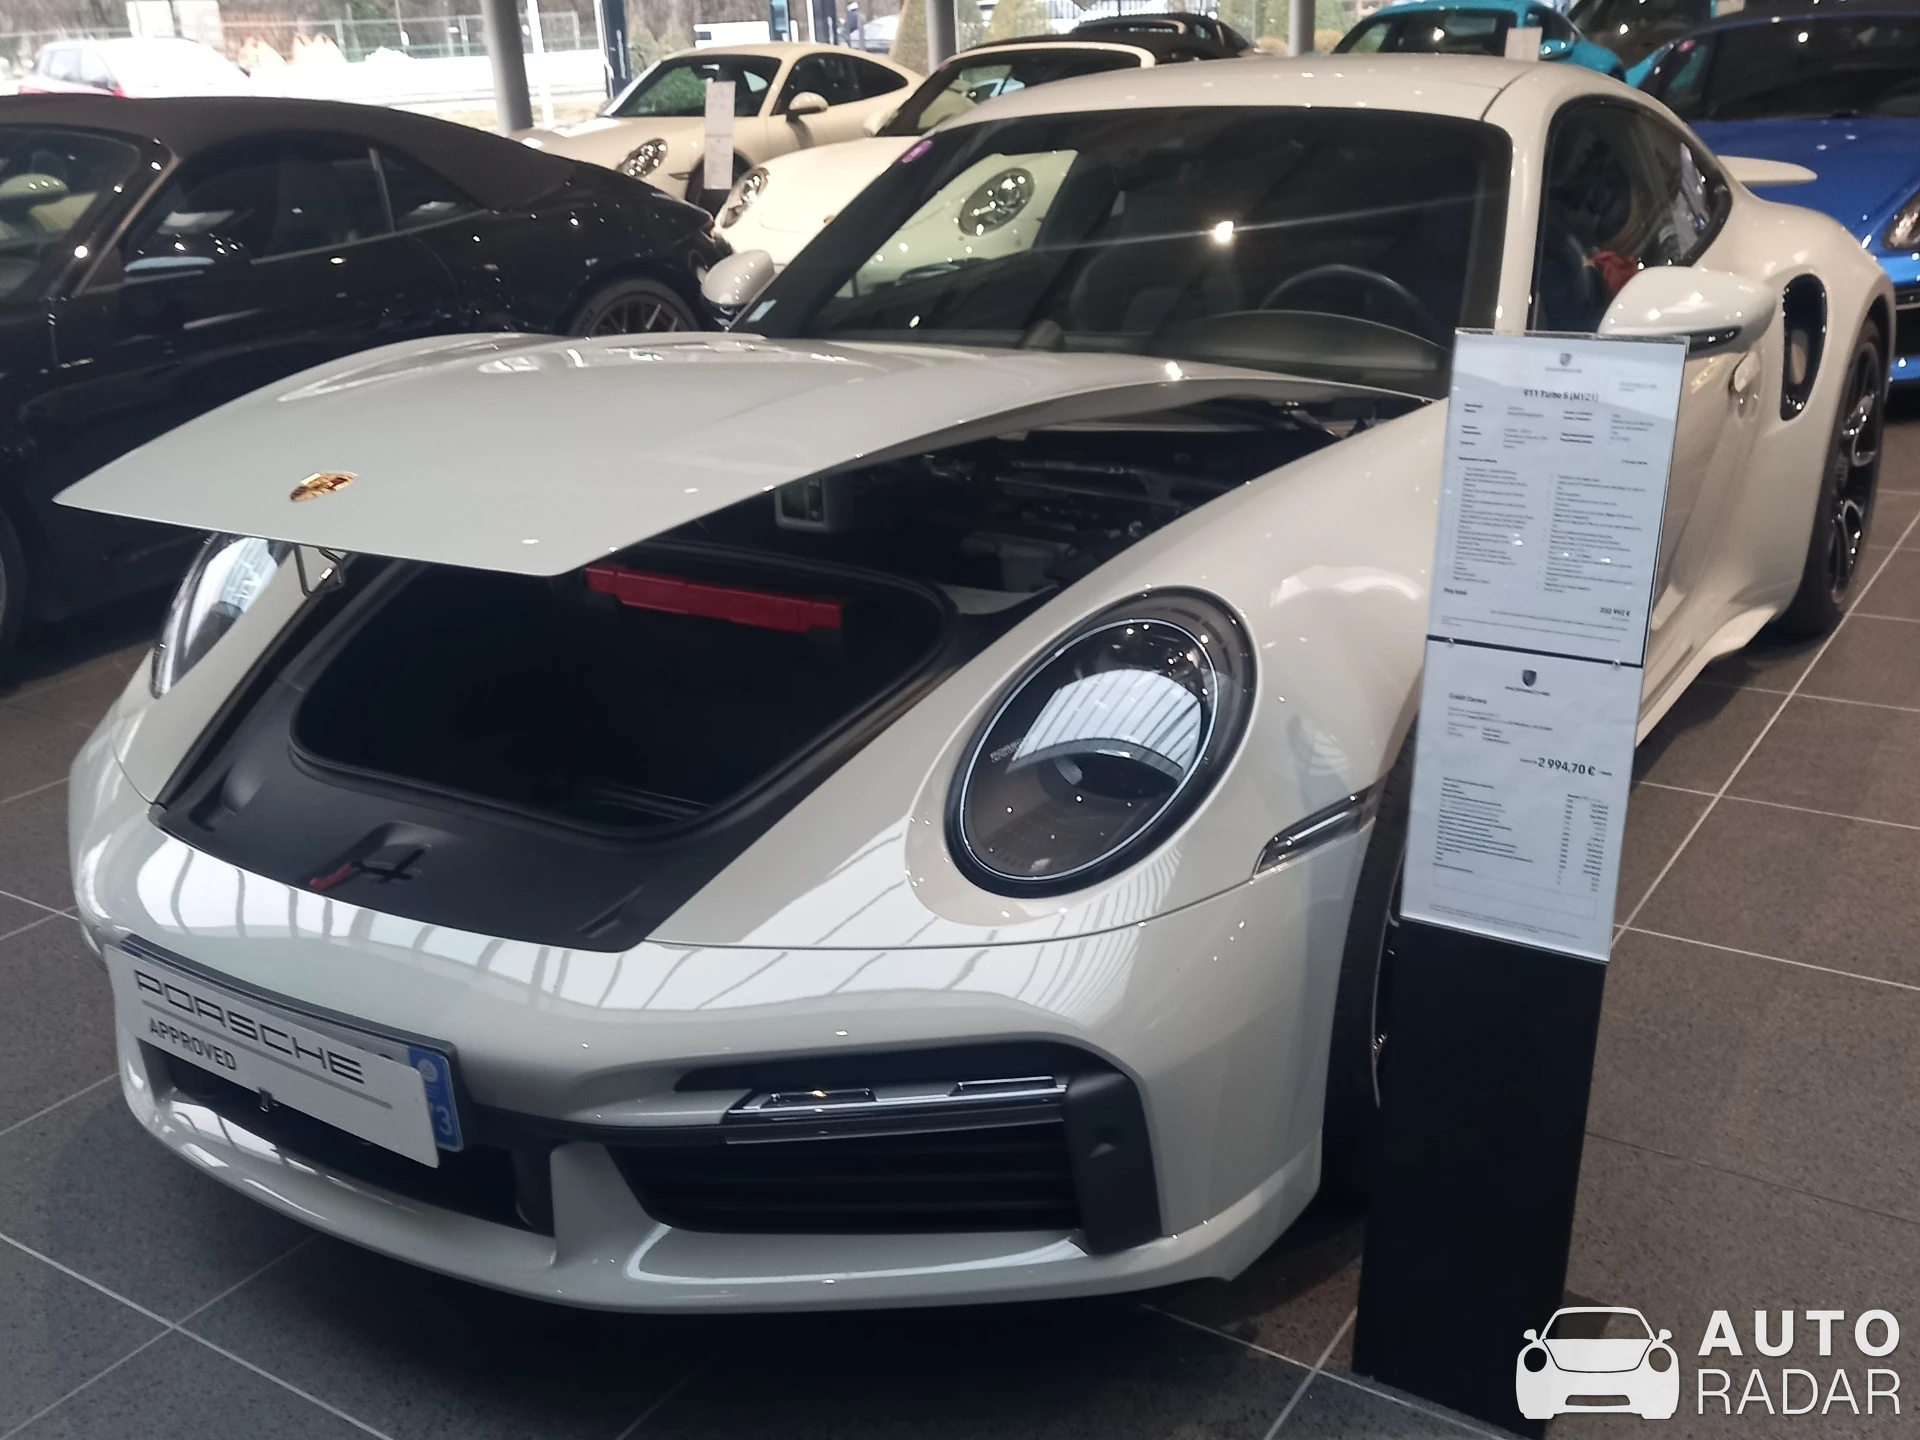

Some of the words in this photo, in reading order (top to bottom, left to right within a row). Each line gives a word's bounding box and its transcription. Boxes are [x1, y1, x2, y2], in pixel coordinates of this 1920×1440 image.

[1541, 390, 1562, 399] Turbo
[1538, 757, 1546, 768] 2
[1547, 758, 1586, 774] 994,70
[1588, 766, 1596, 776] €
[134, 969, 365, 1085] PORSCHE
[149, 1018, 238, 1072] APPROVED
